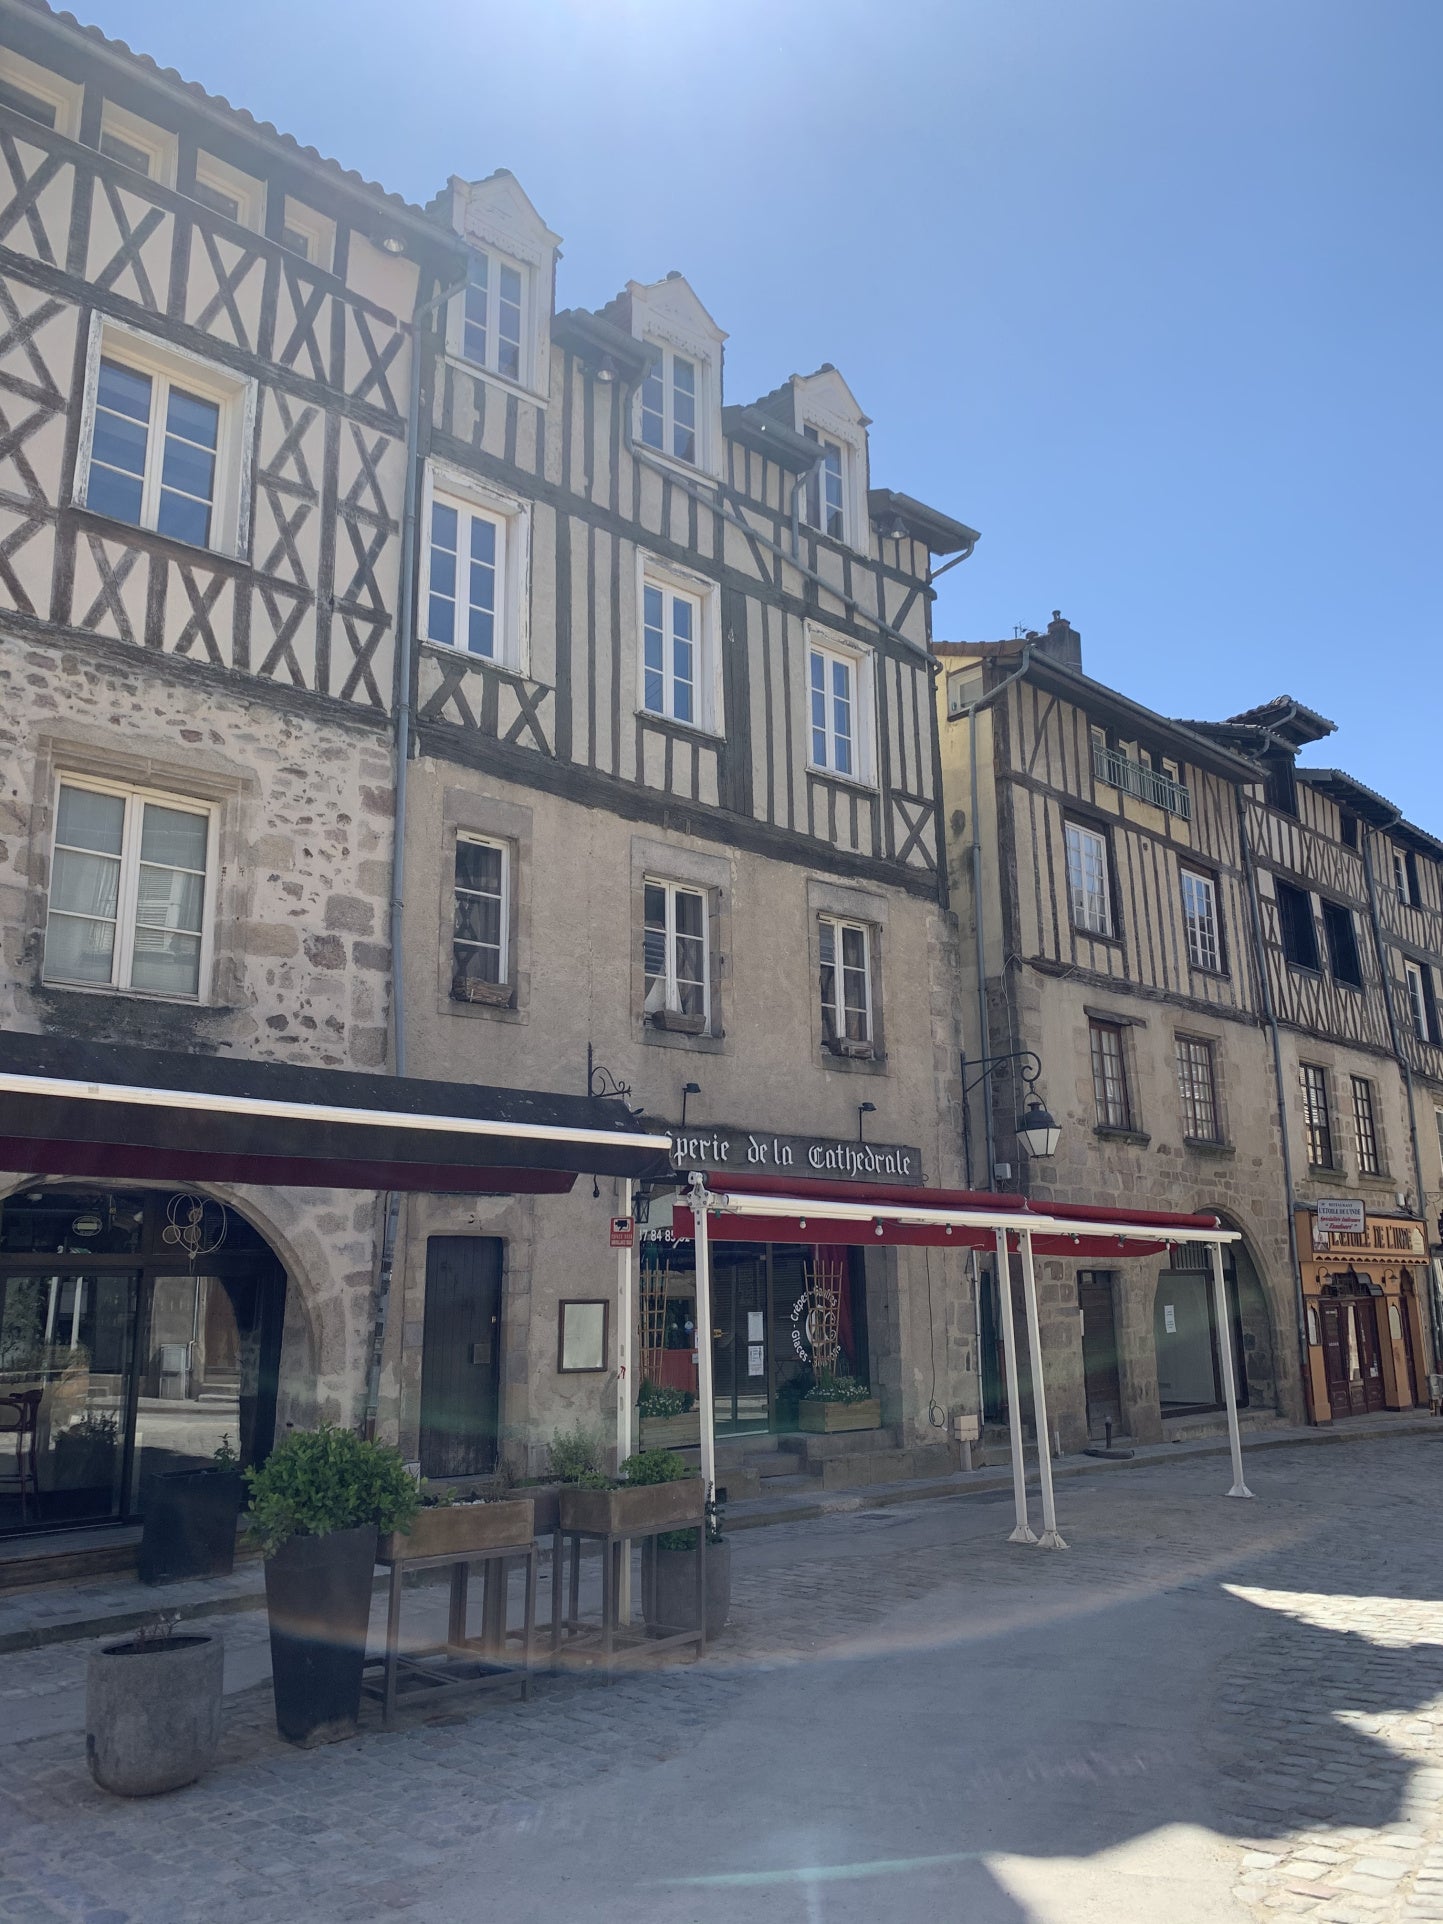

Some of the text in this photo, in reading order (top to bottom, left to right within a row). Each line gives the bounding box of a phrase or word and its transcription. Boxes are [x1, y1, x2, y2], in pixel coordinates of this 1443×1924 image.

[665, 1131, 911, 1177] perie de la Cathedrale
[651, 1229, 662, 1242] 84
[792, 1330, 808, 1362] Glaces
